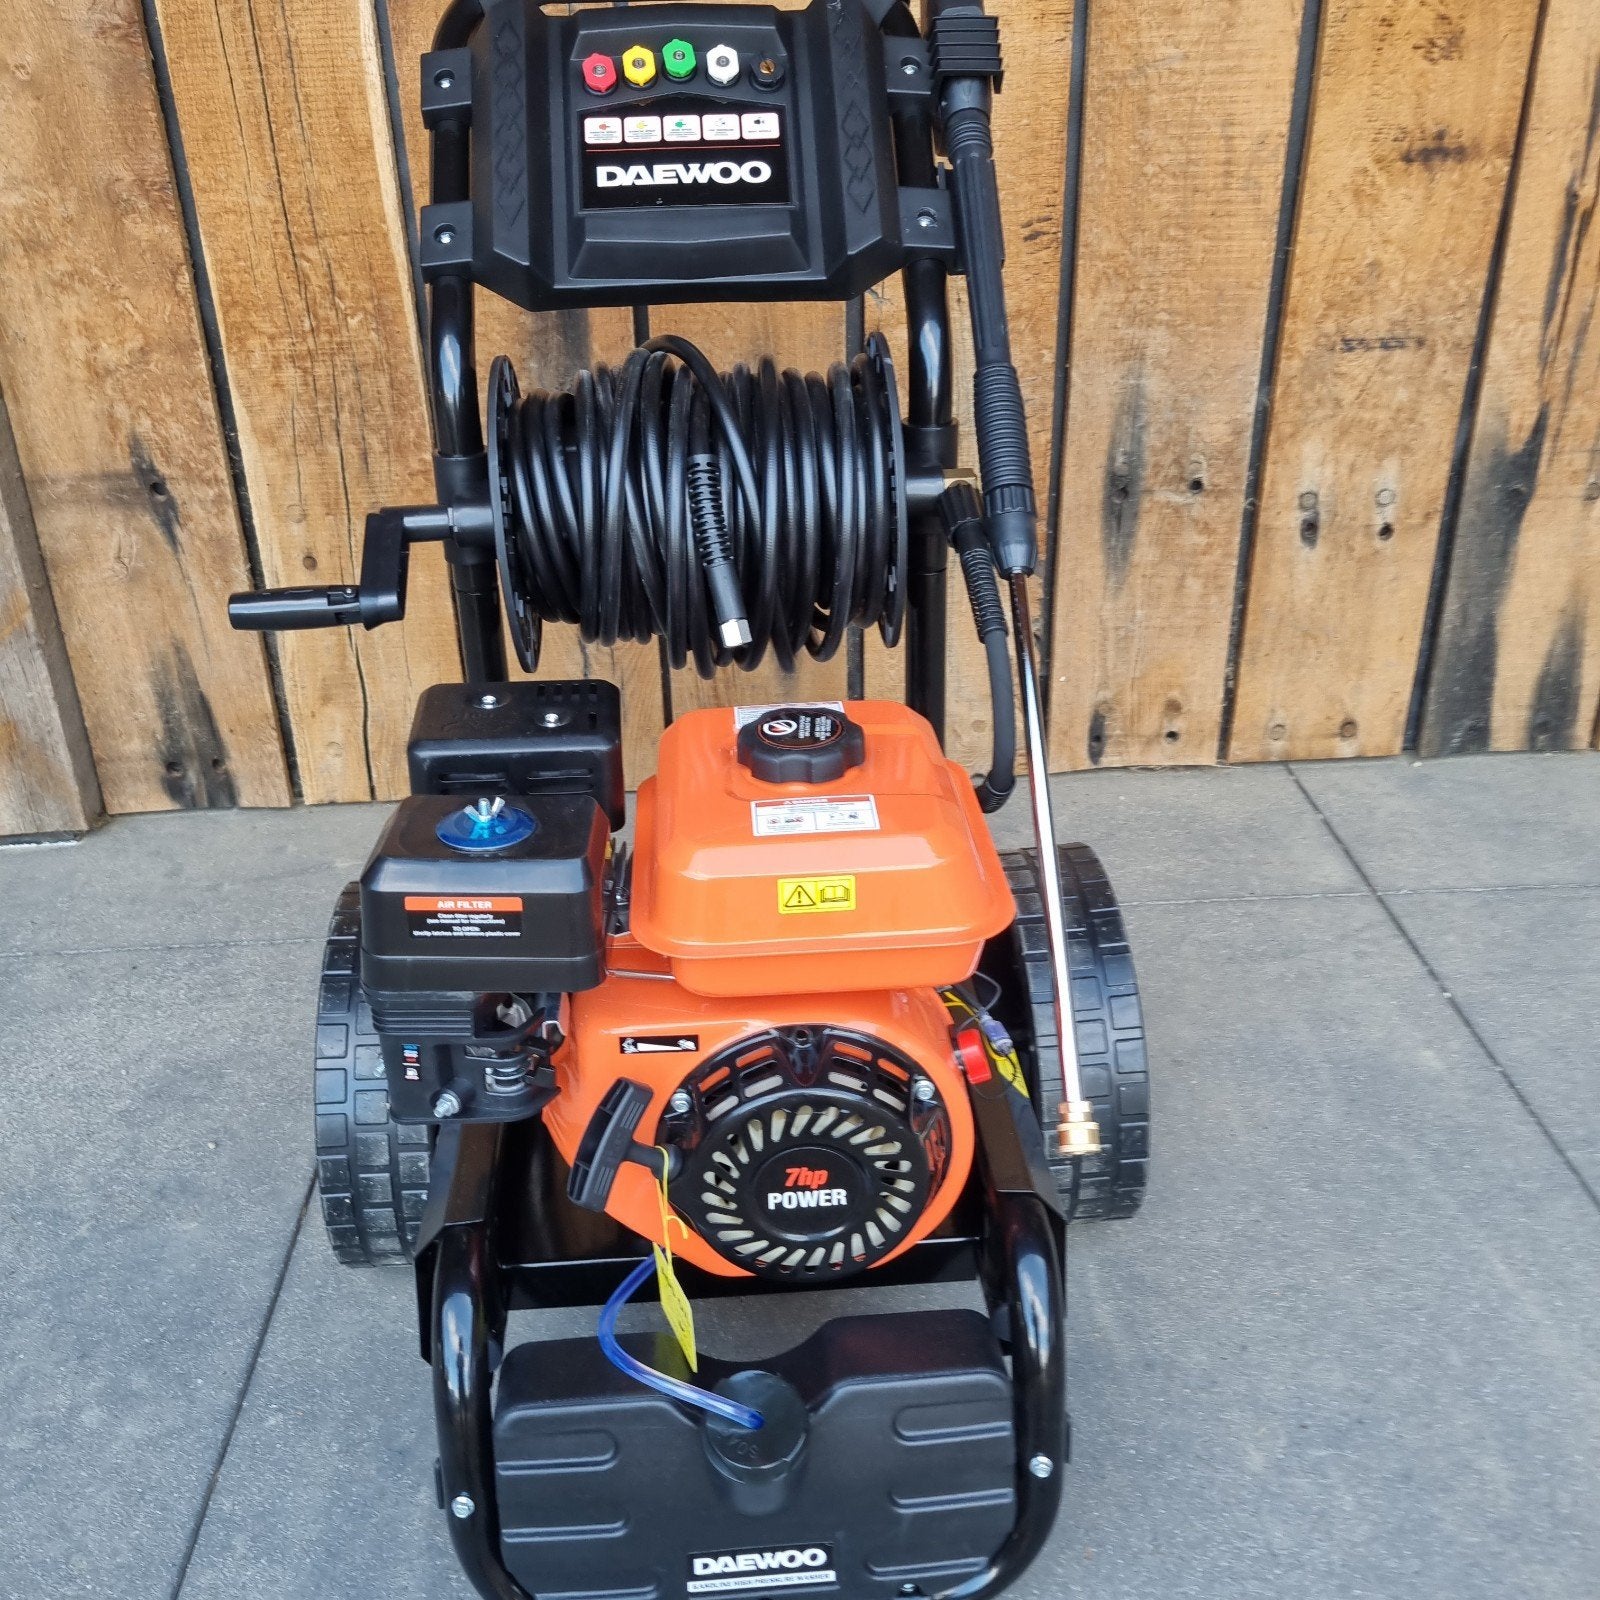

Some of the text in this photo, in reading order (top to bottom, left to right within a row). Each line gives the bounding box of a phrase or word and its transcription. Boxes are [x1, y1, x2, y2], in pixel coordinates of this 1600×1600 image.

[596, 161, 772, 187] DAEWOO
[437, 900, 493, 909] AIR FILTER
[785, 1167, 829, 1189] 7hp
[767, 1188, 848, 1210] POWER
[693, 1548, 828, 1576] DAEWOO
